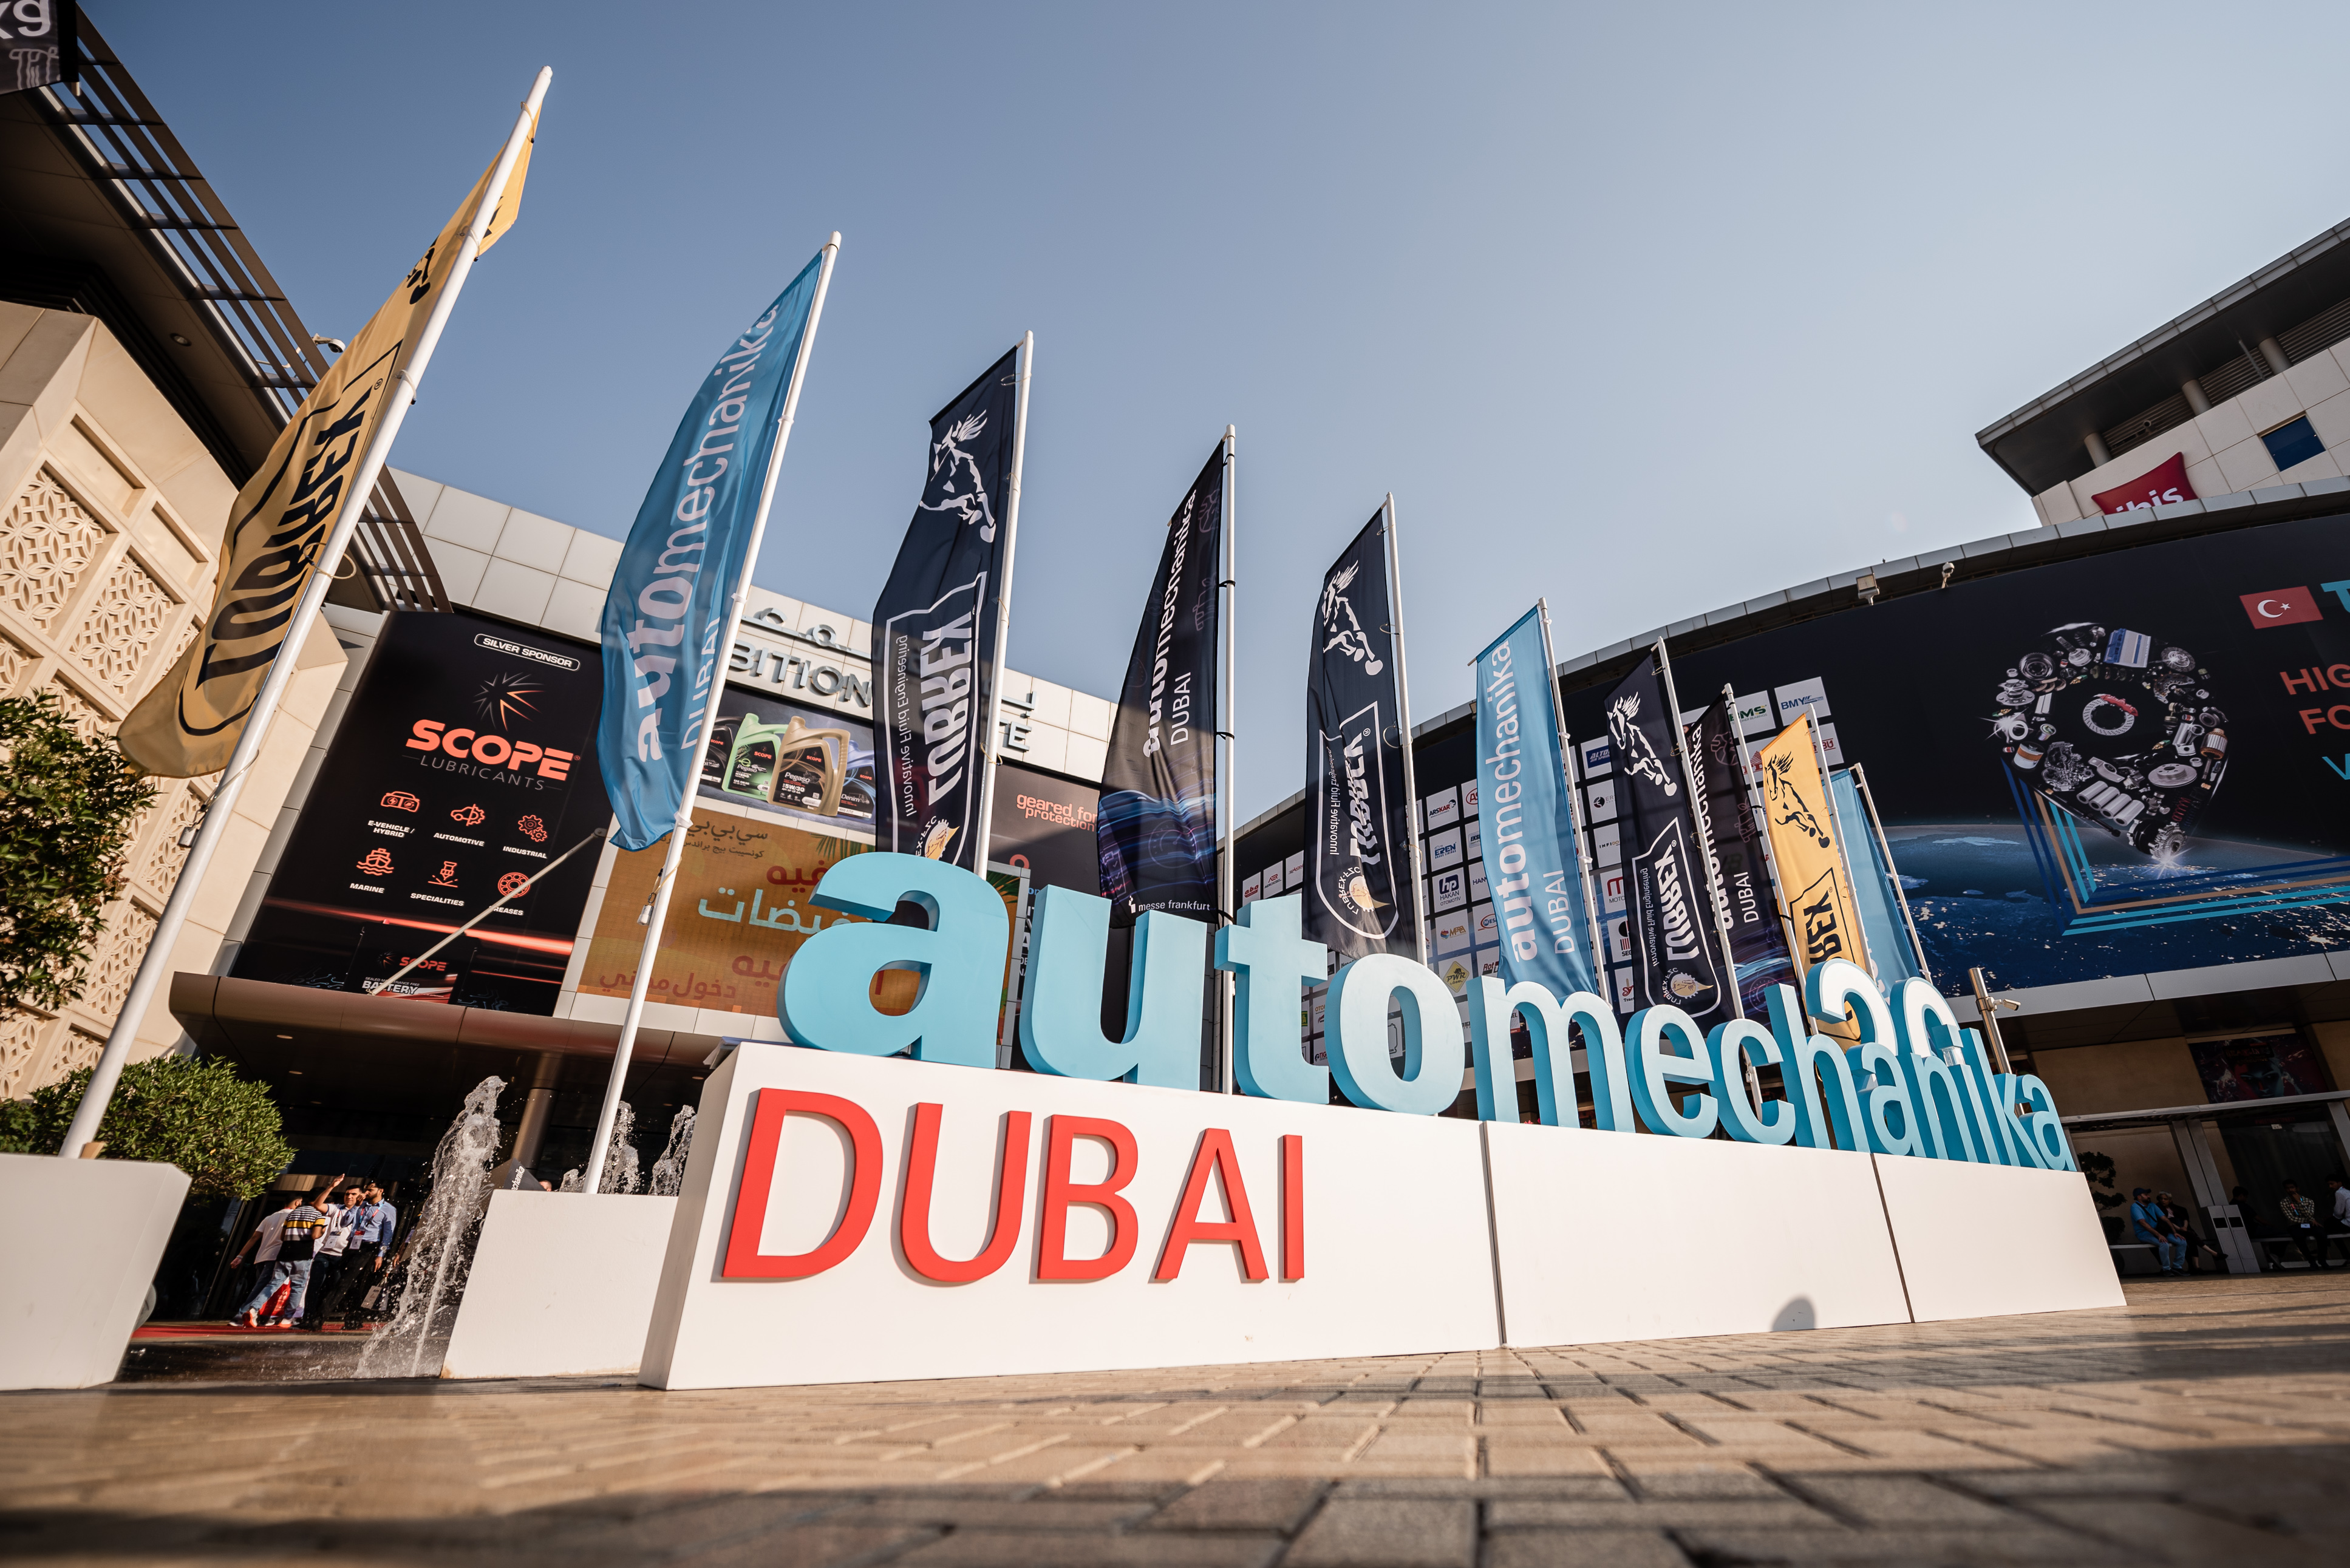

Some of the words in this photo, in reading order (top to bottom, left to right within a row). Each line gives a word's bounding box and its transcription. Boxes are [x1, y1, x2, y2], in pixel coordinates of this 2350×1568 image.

[2116, 487, 2184, 512] is
[1143, 489, 1197, 758] automechanika
[483, 637, 520, 654] SILVER
[522, 648, 572, 668] SPONSOR
[729, 639, 872, 707] BITION
[2280, 663, 2350, 695] HIG
[1170, 671, 1191, 745] DUBAI
[1780, 696, 1805, 710] BMY
[406, 719, 574, 782] SCOPE
[754, 751, 772, 760] SCOPE
[420, 755, 546, 791] LUBRICANTS
[737, 764, 758, 773] Pegaso
[784, 772, 811, 784] Pegaso
[841, 793, 860, 803] Denim
[1485, 640, 1538, 963] automechanika
[1017, 794, 1072, 817] geared
[1077, 807, 1098, 823] for
[1429, 804, 1451, 817] ARSKAR
[368, 820, 410, 833] E-VEHICLE
[1025, 807, 1095, 832] protection
[373, 827, 405, 838] HYBRID
[433, 832, 485, 847] AUTOMOTIVE
[503, 846, 548, 859] INDUSTRIAL
[1434, 843, 1456, 857] EREN
[350, 883, 385, 894] MARINE
[1440, 891, 1459, 901] HAKAN
[1734, 871, 1759, 923] DUBAI
[410, 893, 465, 907] SPECIALITIES
[1139, 901, 1165, 912] messe
[1168, 900, 1210, 911] frankfurt
[1543, 869, 1576, 955] DUBAI
[362, 980, 419, 995] BATERY
[672, 972, 737, 1000] دخول
[777, 852, 2077, 1172] automechanika
[722, 1087, 1304, 1282] DUBAI
